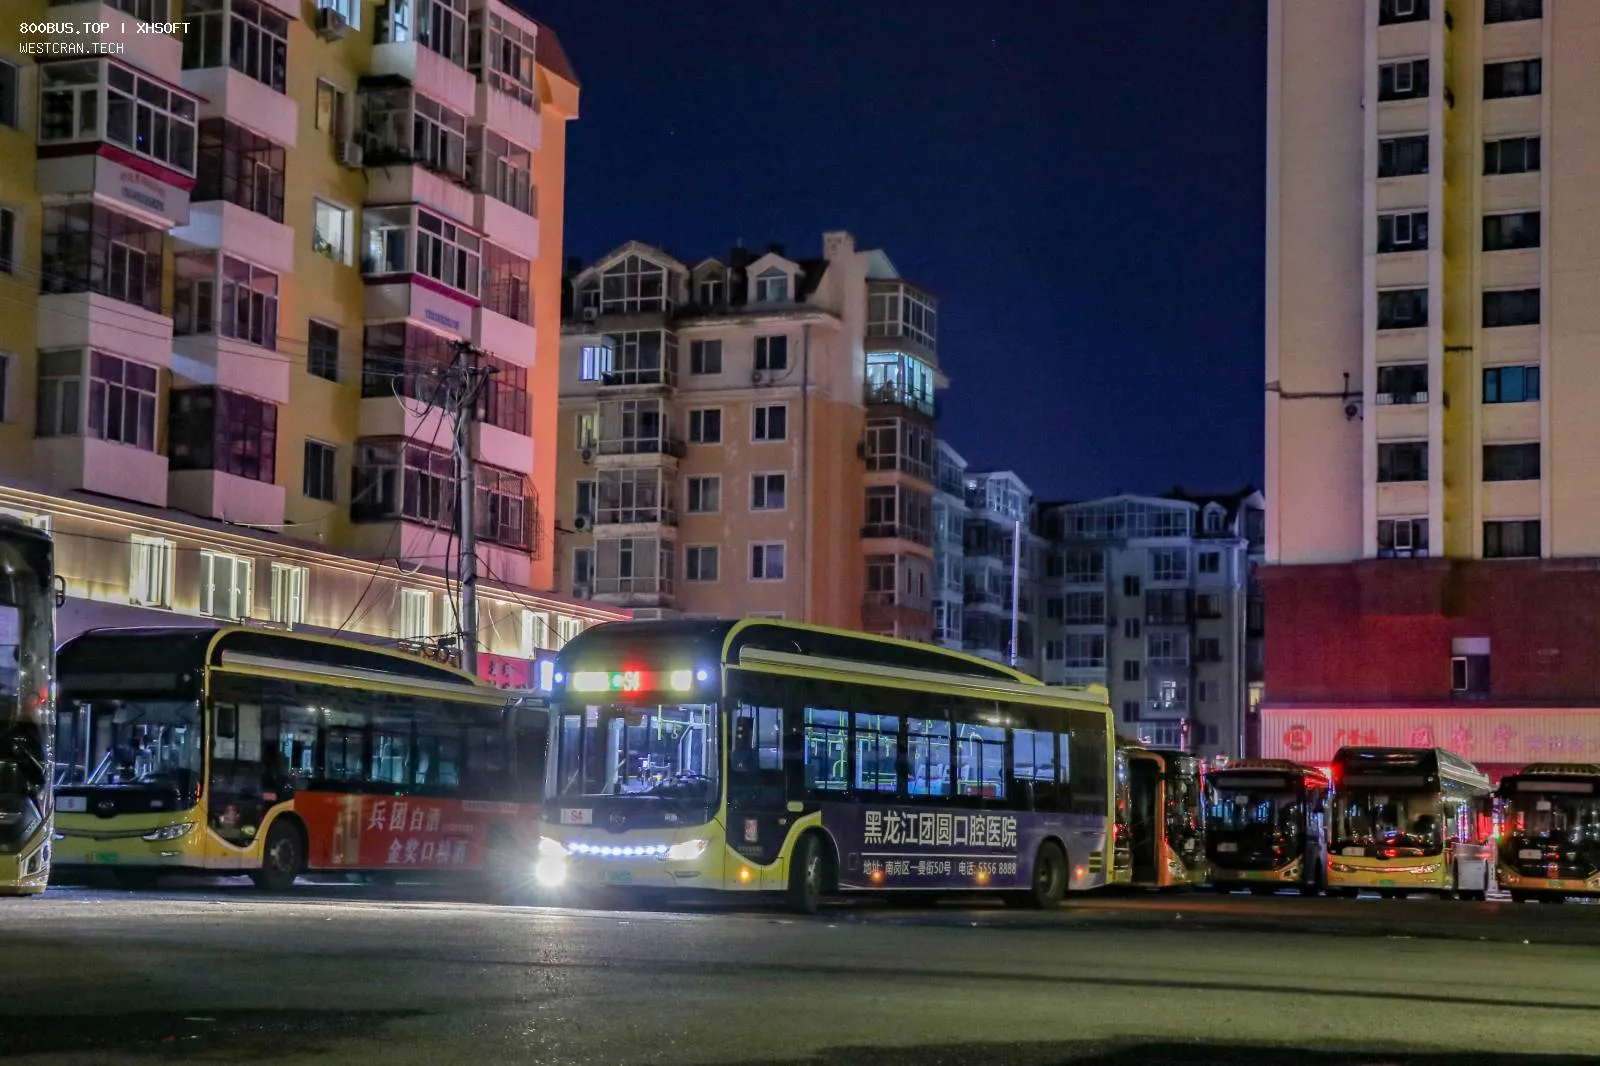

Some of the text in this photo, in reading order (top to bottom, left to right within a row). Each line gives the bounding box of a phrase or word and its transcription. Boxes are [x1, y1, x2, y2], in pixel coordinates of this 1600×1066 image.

[864, 810, 1017, 847] 黑龙江团圆口腔医院
[885, 860, 951, 876] 南岗区一曼街50号
[998, 862, 1017, 875] 8888
